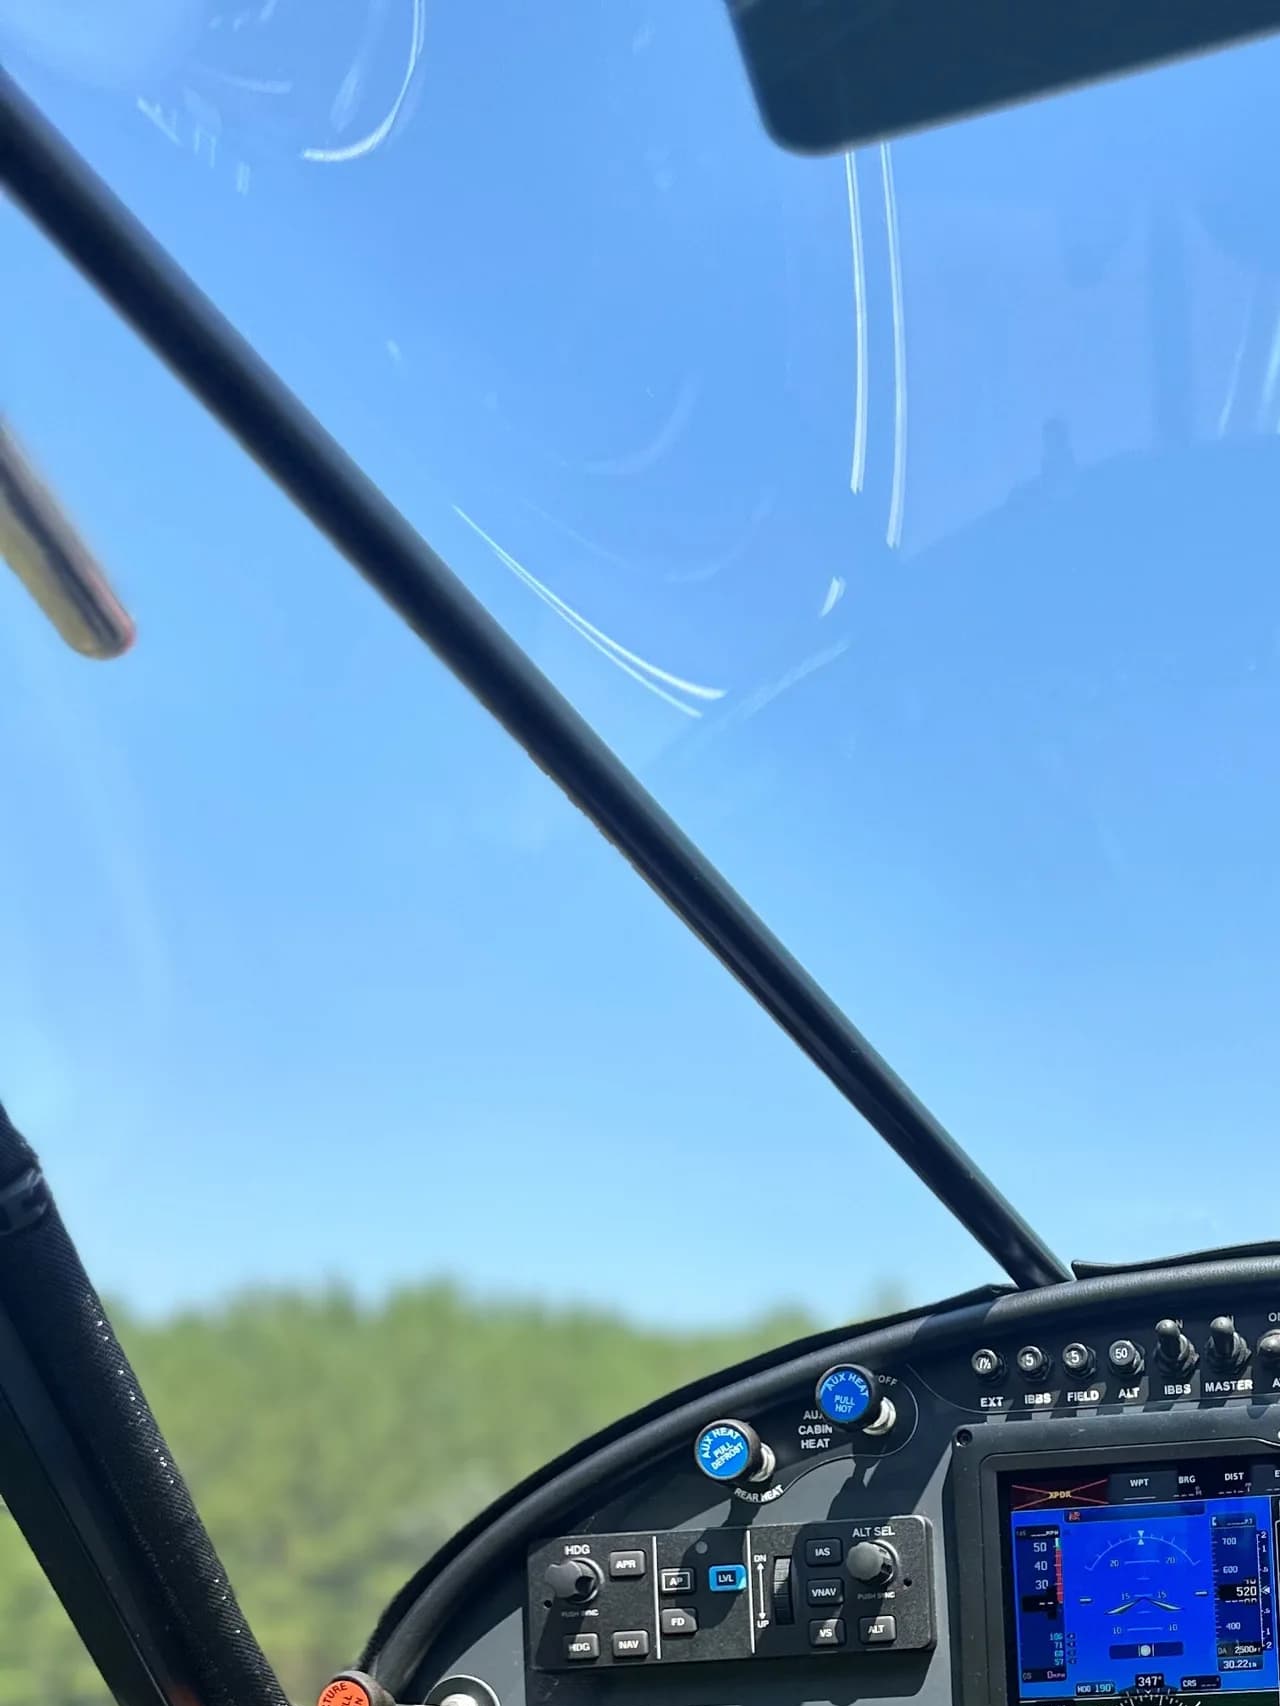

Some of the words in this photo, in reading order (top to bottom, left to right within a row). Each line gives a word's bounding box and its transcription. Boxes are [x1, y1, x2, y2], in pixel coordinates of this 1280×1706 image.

[1115, 1348, 1128, 1359] 50
[1164, 1384, 1191, 1395] IBBS
[1205, 1380, 1253, 1392] MASTER
[1067, 1390, 1099, 1402] FIELD
[1119, 1387, 1140, 1399] ALT
[834, 1395, 855, 1406] PULL
[980, 1397, 1003, 1408] EXT
[1025, 1393, 1051, 1404] IBBS
[798, 1425, 832, 1434] CABIN
[801, 1438, 830, 1449] HEAT
[1178, 1475, 1195, 1484] BRG
[1225, 1472, 1244, 1481] DIST
[1130, 1479, 1149, 1487] WPT
[734, 1487, 759, 1502] REAR
[760, 1484, 784, 1501] HEAT
[852, 1528, 870, 1537] ALT
[874, 1526, 895, 1536] SEL
[565, 1545, 590, 1555] HDG
[1034, 1542, 1046, 1552] 50
[815, 1548, 830, 1556] IAS
[615, 1560, 636, 1569] APR
[1034, 1561, 1048, 1570] 40
[718, 1574, 734, 1583] LVL
[1035, 1580, 1048, 1589] 30
[812, 1588, 836, 1597] VNAV
[1236, 1586, 1257, 1596] 520
[671, 1617, 685, 1626] FD
[757, 1620, 769, 1628] UP
[868, 1625, 885, 1634] ALT
[568, 1643, 590, 1652] HDG
[618, 1640, 639, 1649] NAV
